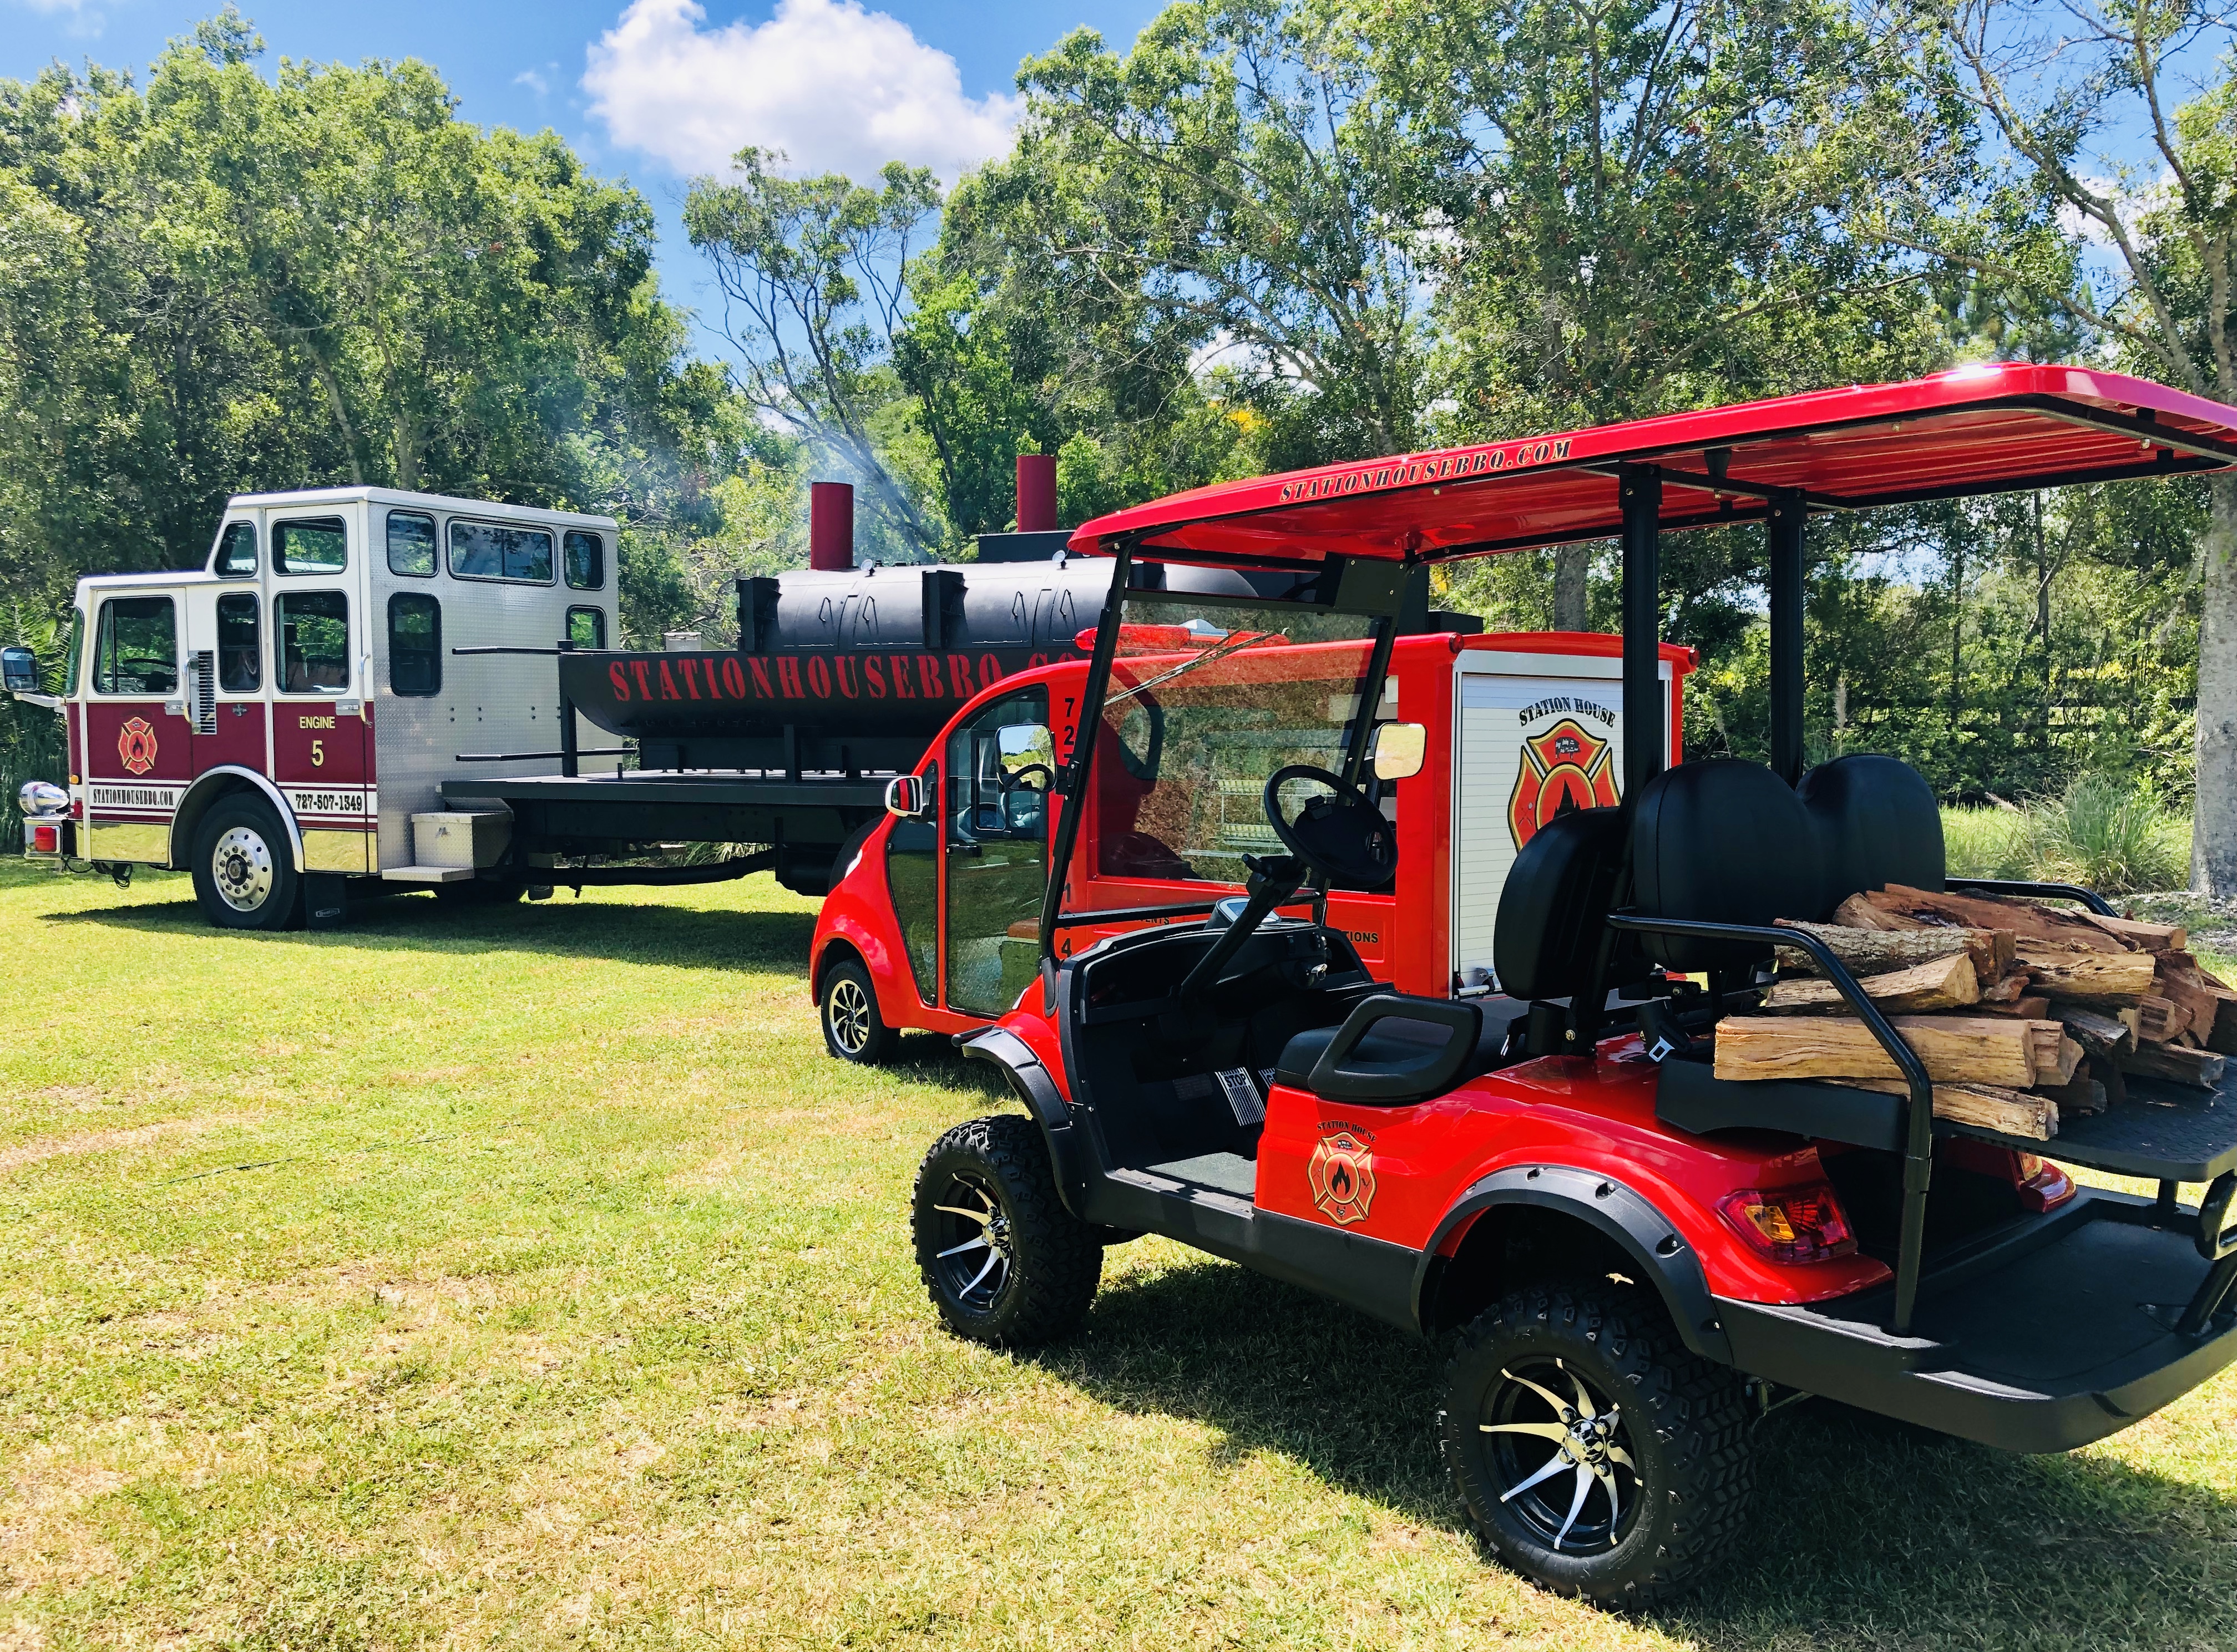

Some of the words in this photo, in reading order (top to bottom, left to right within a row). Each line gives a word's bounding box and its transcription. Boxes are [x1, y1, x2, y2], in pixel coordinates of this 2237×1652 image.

[1280, 440, 1572, 501] STATIONHOUSEBBQ.COM
[299, 716, 336, 729] ENGINE
[1519, 697, 1571, 727] STATION
[1573, 698, 1616, 728] HOUSE
[311, 739, 325, 767] 5
[93, 789, 174, 805] STATIONHOUSEBBQ.COM
[295, 793, 362, 811] 727-507-1349
[1224, 1073, 1247, 1088] STOP
[1317, 1121, 1349, 1131] STATION
[1352, 1123, 1377, 1143] HOUSE
